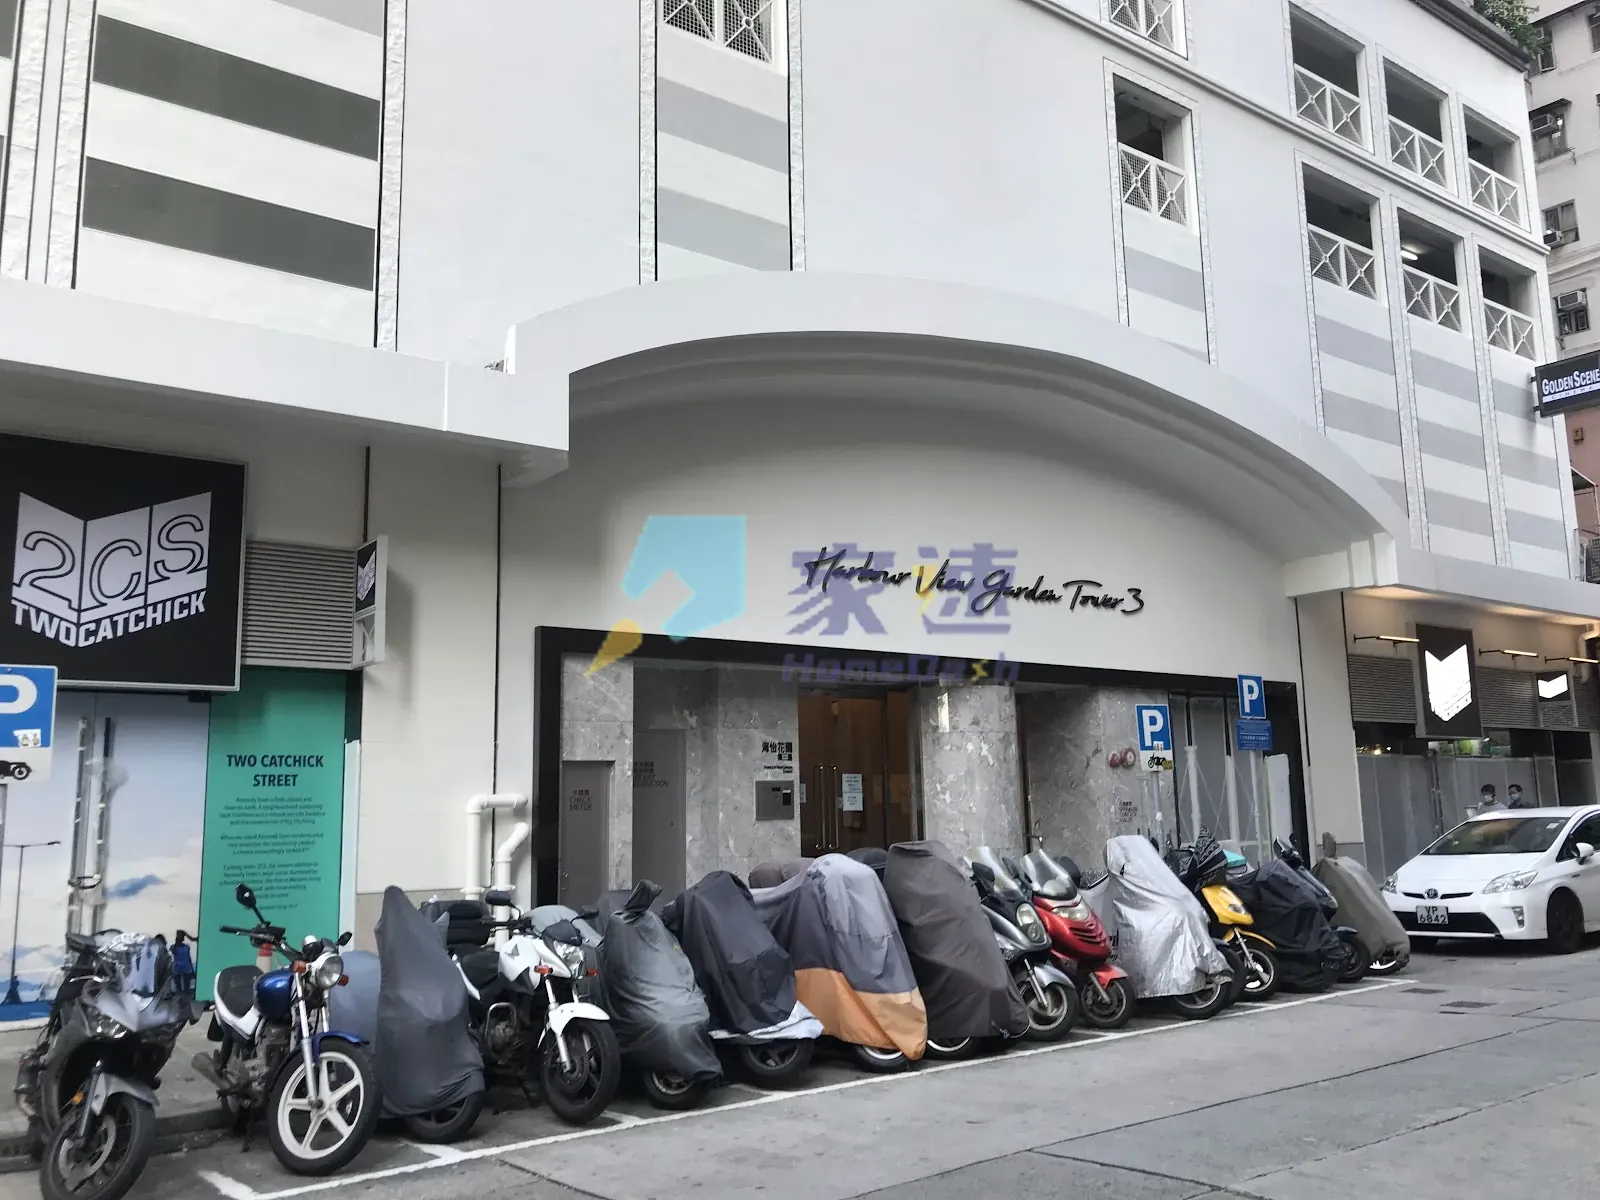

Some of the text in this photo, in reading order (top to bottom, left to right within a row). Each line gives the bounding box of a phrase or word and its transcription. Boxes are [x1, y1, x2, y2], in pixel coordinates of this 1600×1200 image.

[12, 514, 208, 611] 2CS
[804, 547, 912, 592] Harbour
[915, 559, 977, 596] View
[1063, 580, 1124, 612] Tower
[1120, 588, 1145, 615] 3
[1242, 679, 1260, 713] P
[1142, 709, 1164, 747] P
[227, 754, 324, 768] TWO CATCHICK
[252, 774, 299, 787] STREET
[1420, 914, 1447, 924] 6842
